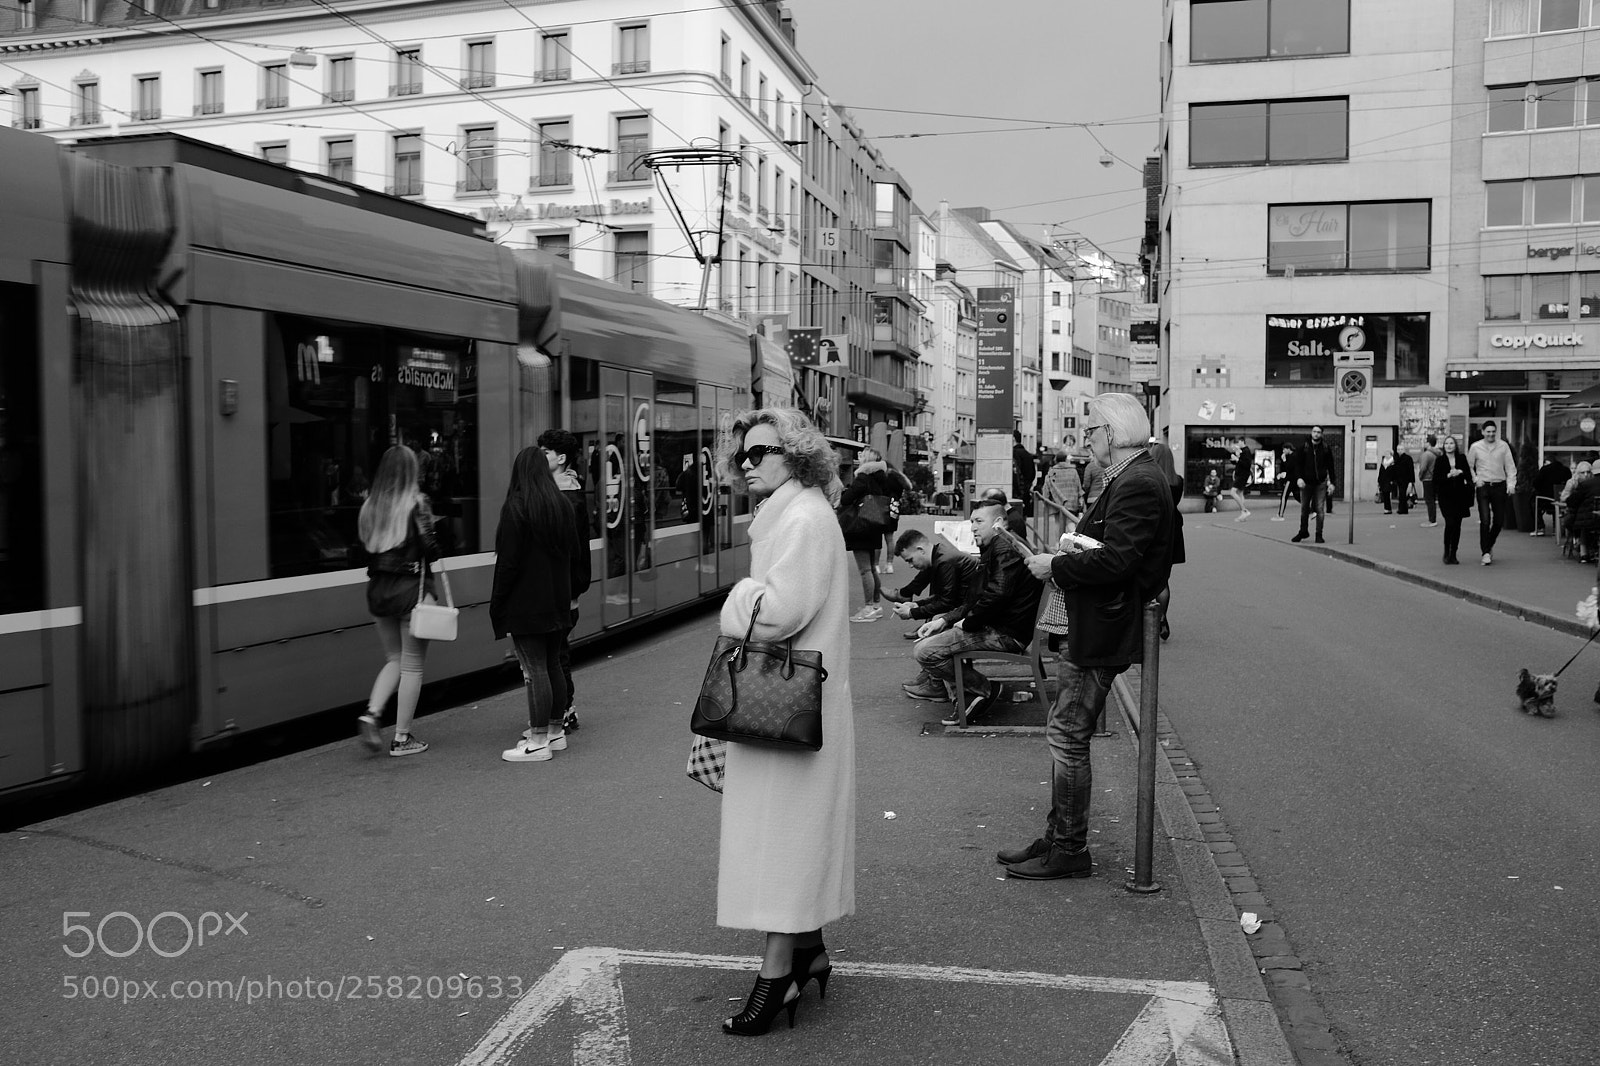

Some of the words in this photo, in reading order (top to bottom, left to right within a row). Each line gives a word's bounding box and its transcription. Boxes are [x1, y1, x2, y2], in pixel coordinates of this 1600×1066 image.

[610, 197, 654, 215] Basel
[1289, 209, 1339, 237] Hair
[823, 232, 836, 247] 15
[1527, 245, 1575, 261] berger
[1287, 340, 1331, 356] Salt.
[1490, 332, 1584, 351] CopyQuick
